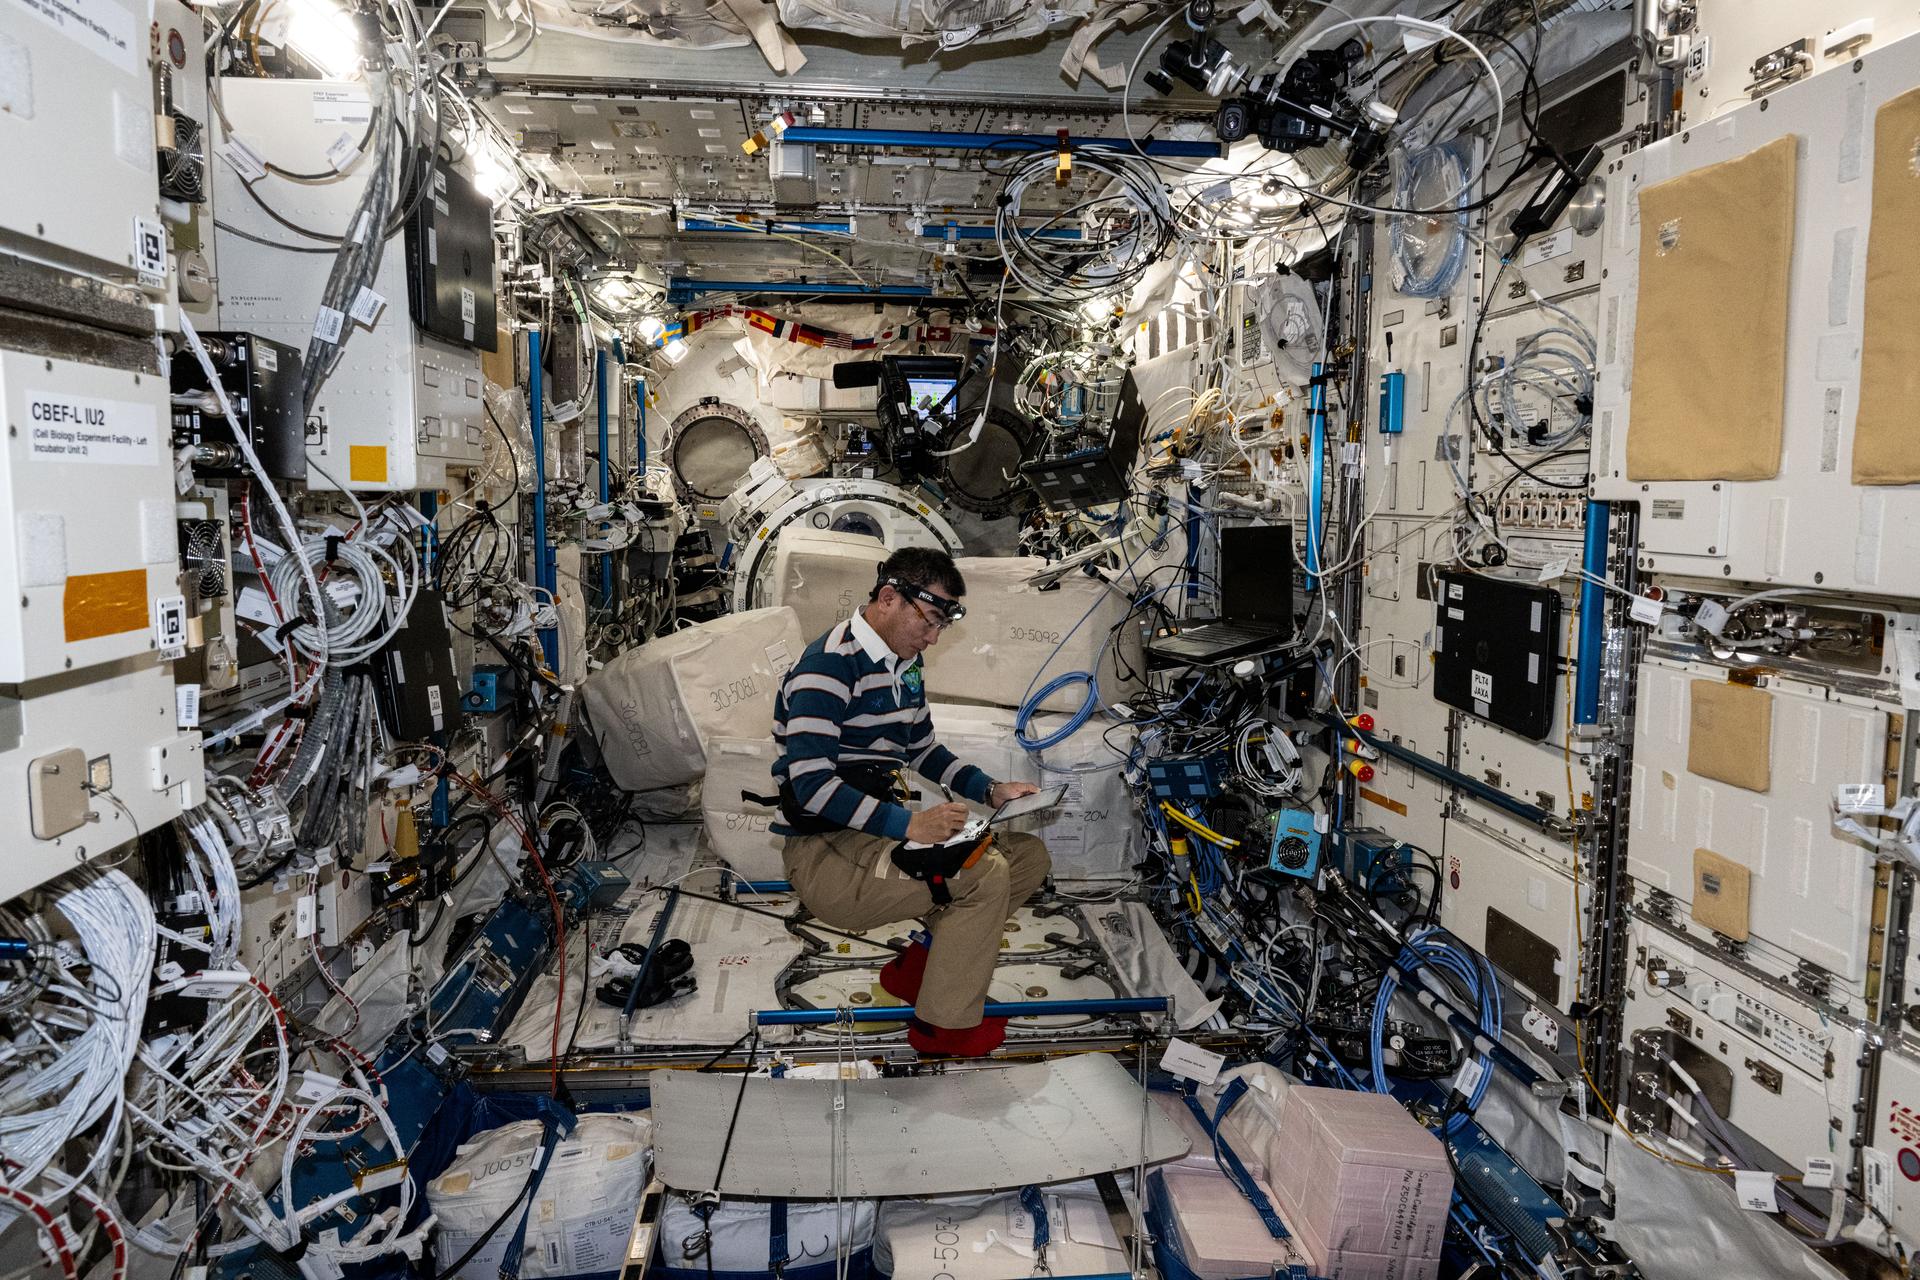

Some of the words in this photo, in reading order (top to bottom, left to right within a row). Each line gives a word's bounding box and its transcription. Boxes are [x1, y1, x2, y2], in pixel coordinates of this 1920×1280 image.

[32, 402, 82, 424] CBEF-L
[85, 407, 105, 426] IU2
[33, 429, 49, 440] (Cell
[50, 430, 75, 443] Biology
[77, 431, 111, 443] Experiment
[112, 434, 132, 446] Facility
[137, 437, 147, 445] Left
[34, 443, 66, 453] Incubator
[67, 445, 81, 454] Unit
[82, 446, 88, 456] 2)
[1009, 626, 1060, 645] 30-5092
[1474, 673, 1489, 686] PLT4
[708, 675, 760, 712] 30-5081
[1473, 686, 1489, 699] JAXA
[620, 699, 652, 760] 30-5081
[1415, 1171, 1429, 1198] Sample
